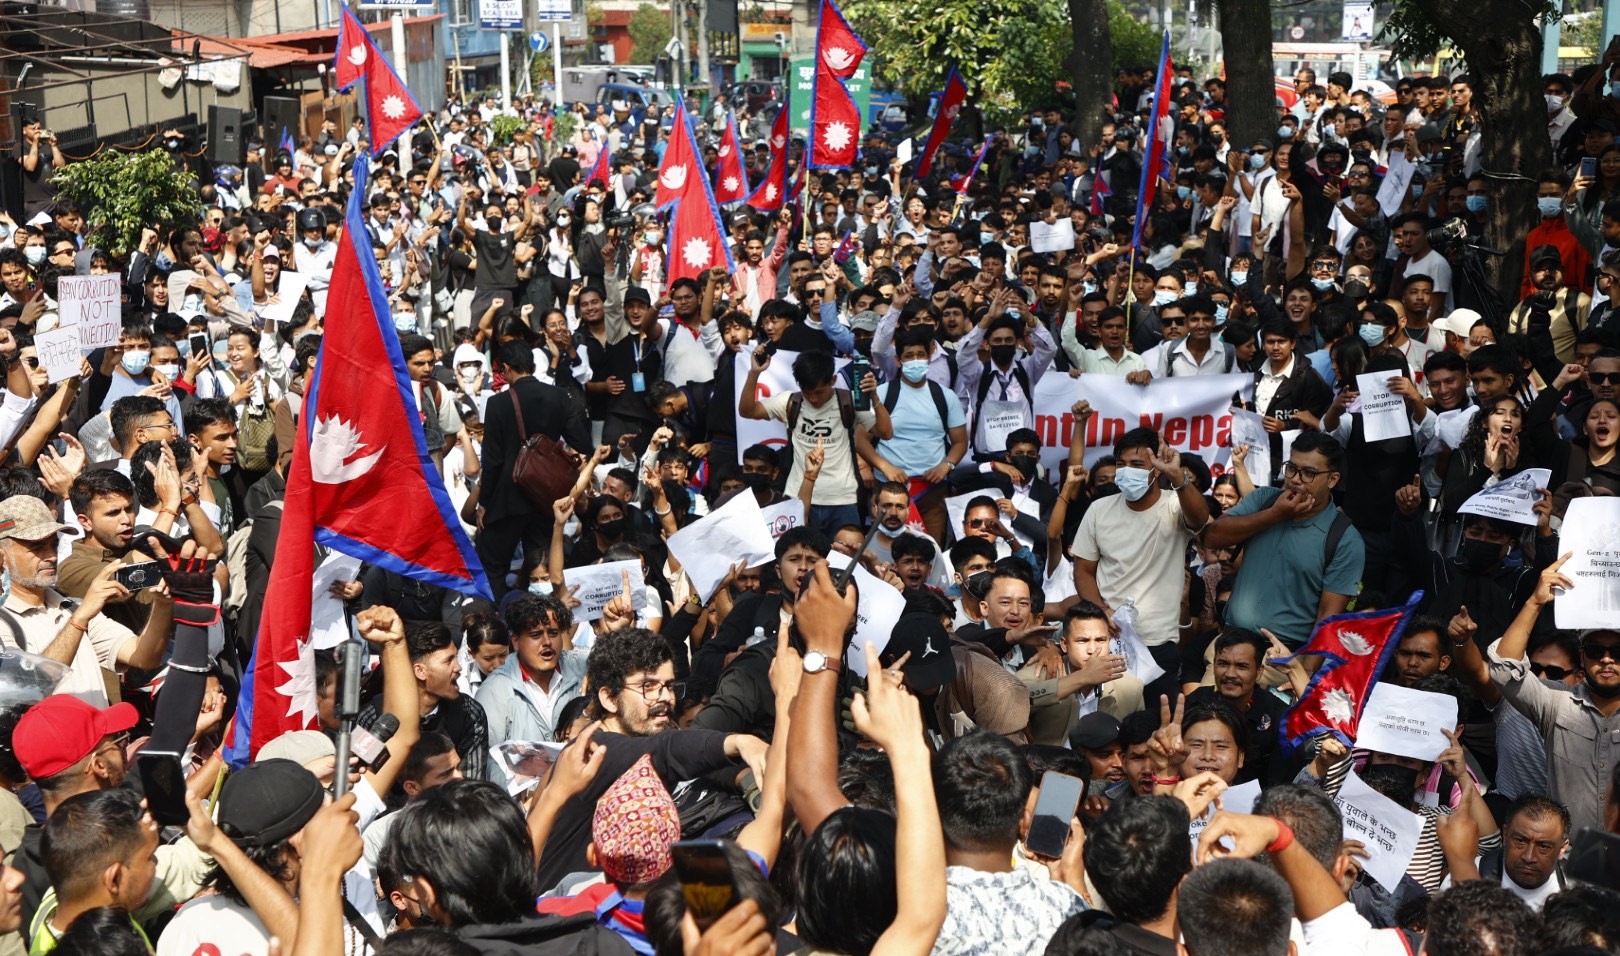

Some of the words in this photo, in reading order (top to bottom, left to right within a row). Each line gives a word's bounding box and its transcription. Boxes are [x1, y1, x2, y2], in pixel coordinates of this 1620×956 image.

[80, 300, 113, 322] NOT
[1363, 399, 1403, 411] CORRUPTION
[1373, 392, 1390, 401] STOP
[1035, 411, 1081, 448] nt
[1139, 411, 1233, 451] Nepa
[585, 589, 624, 600] CORRUPTIO
[1346, 803, 1369, 821] युवाले
[1369, 813, 1379, 827] के
[1346, 817, 1368, 835] बोल्न
[1368, 826, 1376, 841] दे
